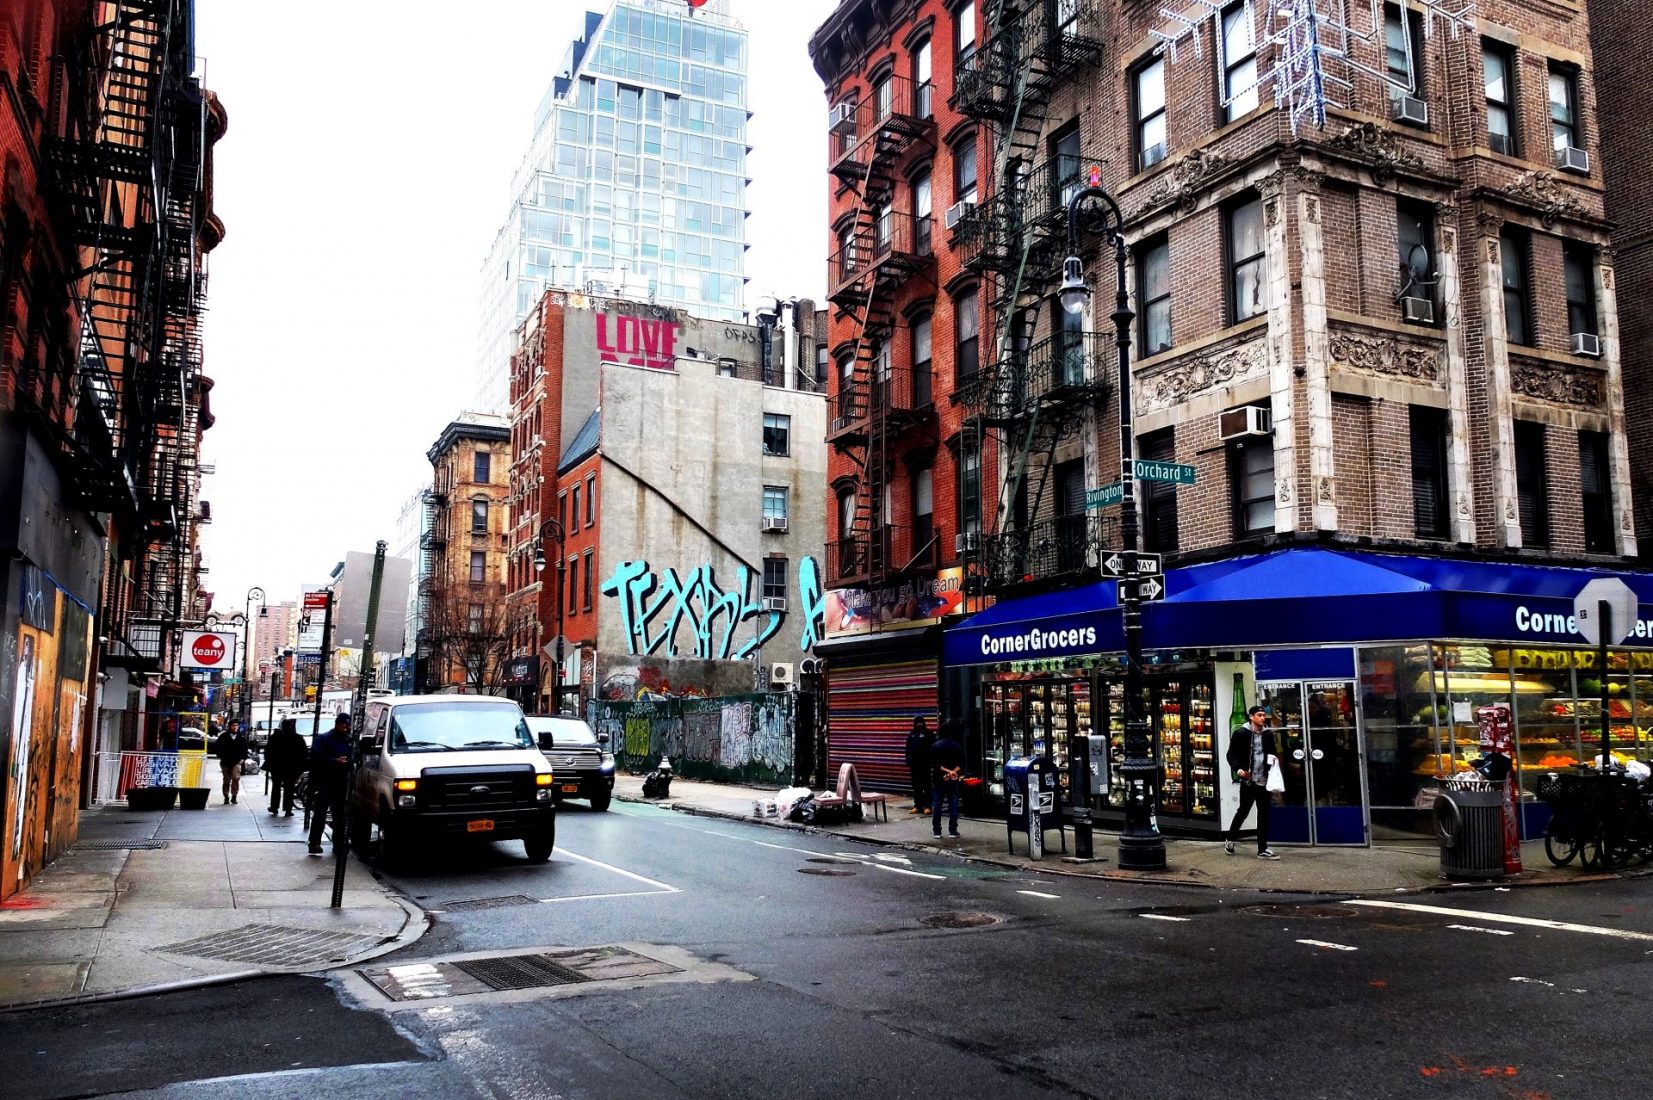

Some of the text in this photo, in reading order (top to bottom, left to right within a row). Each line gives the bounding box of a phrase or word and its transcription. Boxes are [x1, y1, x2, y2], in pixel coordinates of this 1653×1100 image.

[596, 313, 681, 359] LOVE
[1136, 462, 1192, 480] Orchard St
[1086, 485, 1122, 504] Rivington
[1143, 584, 1157, 594] WAY
[981, 627, 1096, 655] CornerGrocers
[193, 647, 224, 658] teany
[1312, 682, 1346, 690] ENTRANCE
